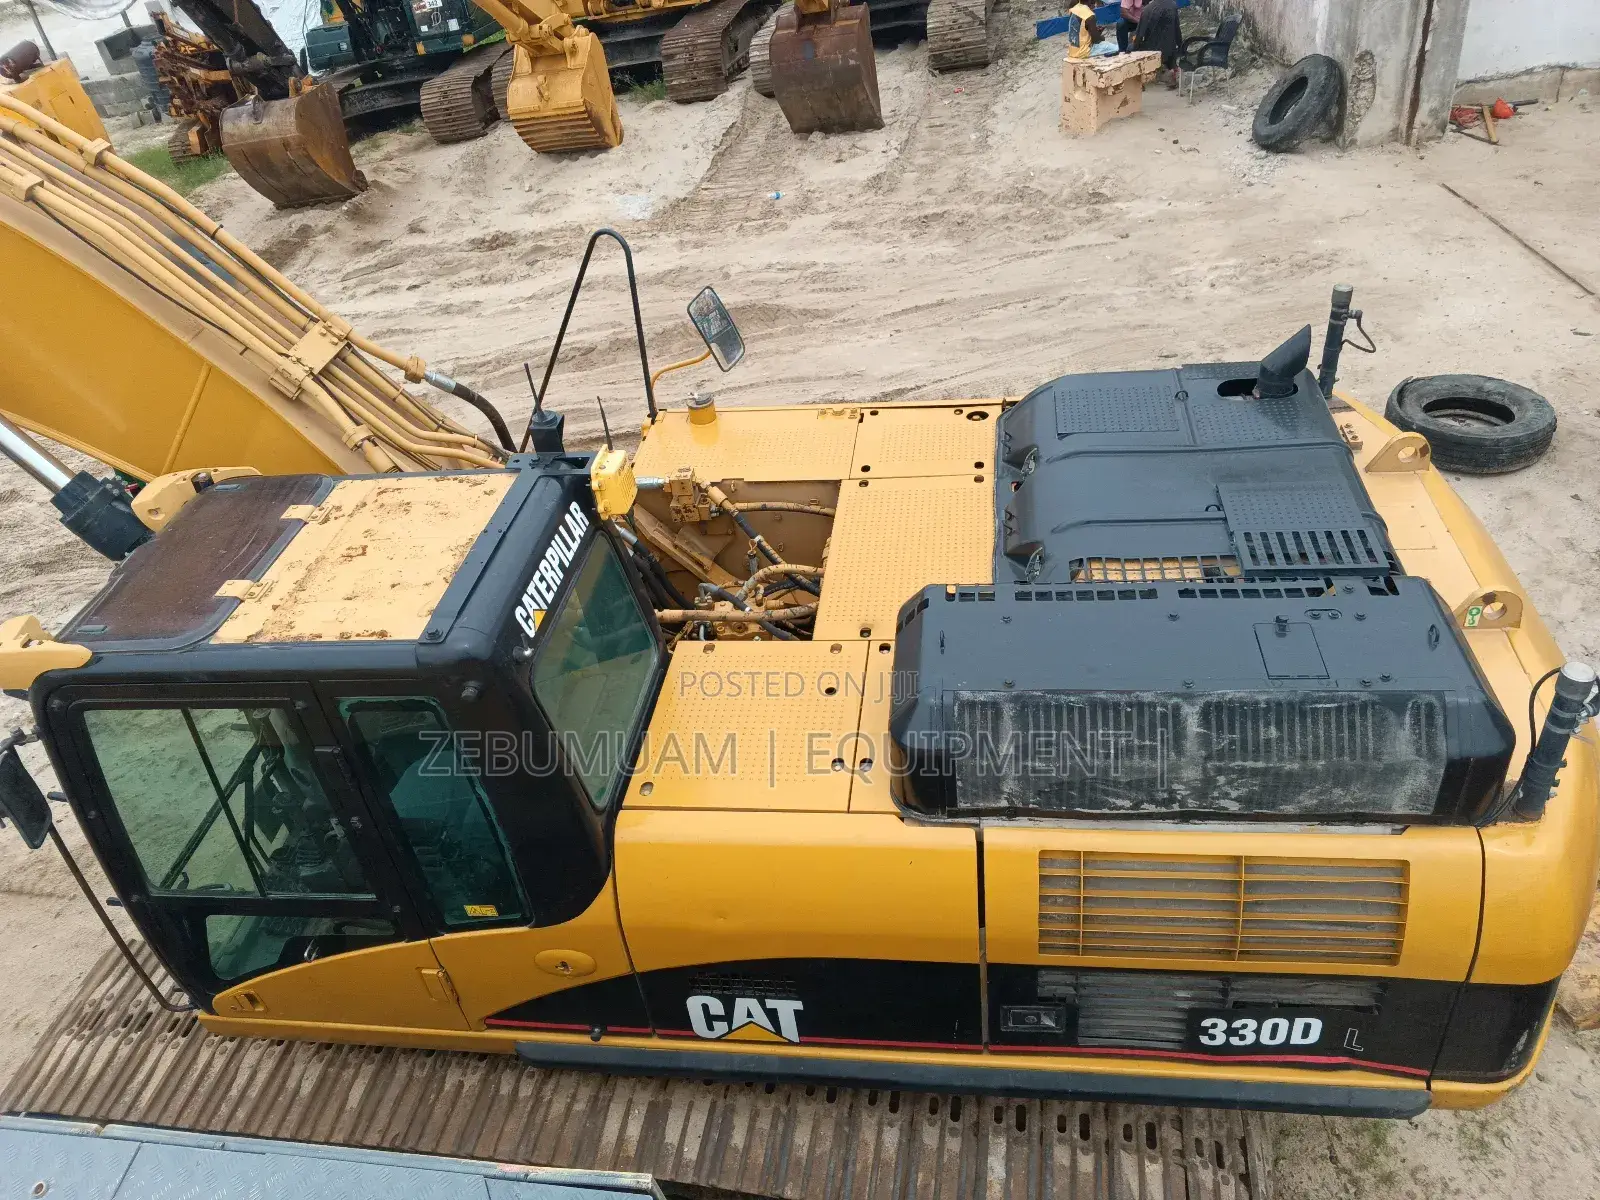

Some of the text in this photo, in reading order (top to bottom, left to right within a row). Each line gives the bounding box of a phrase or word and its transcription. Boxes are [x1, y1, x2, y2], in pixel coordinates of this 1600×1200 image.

[514, 501, 590, 638] CATERPILLAR
[686, 995, 804, 1043] CAT
[1199, 1017, 1364, 1051] 330D L
